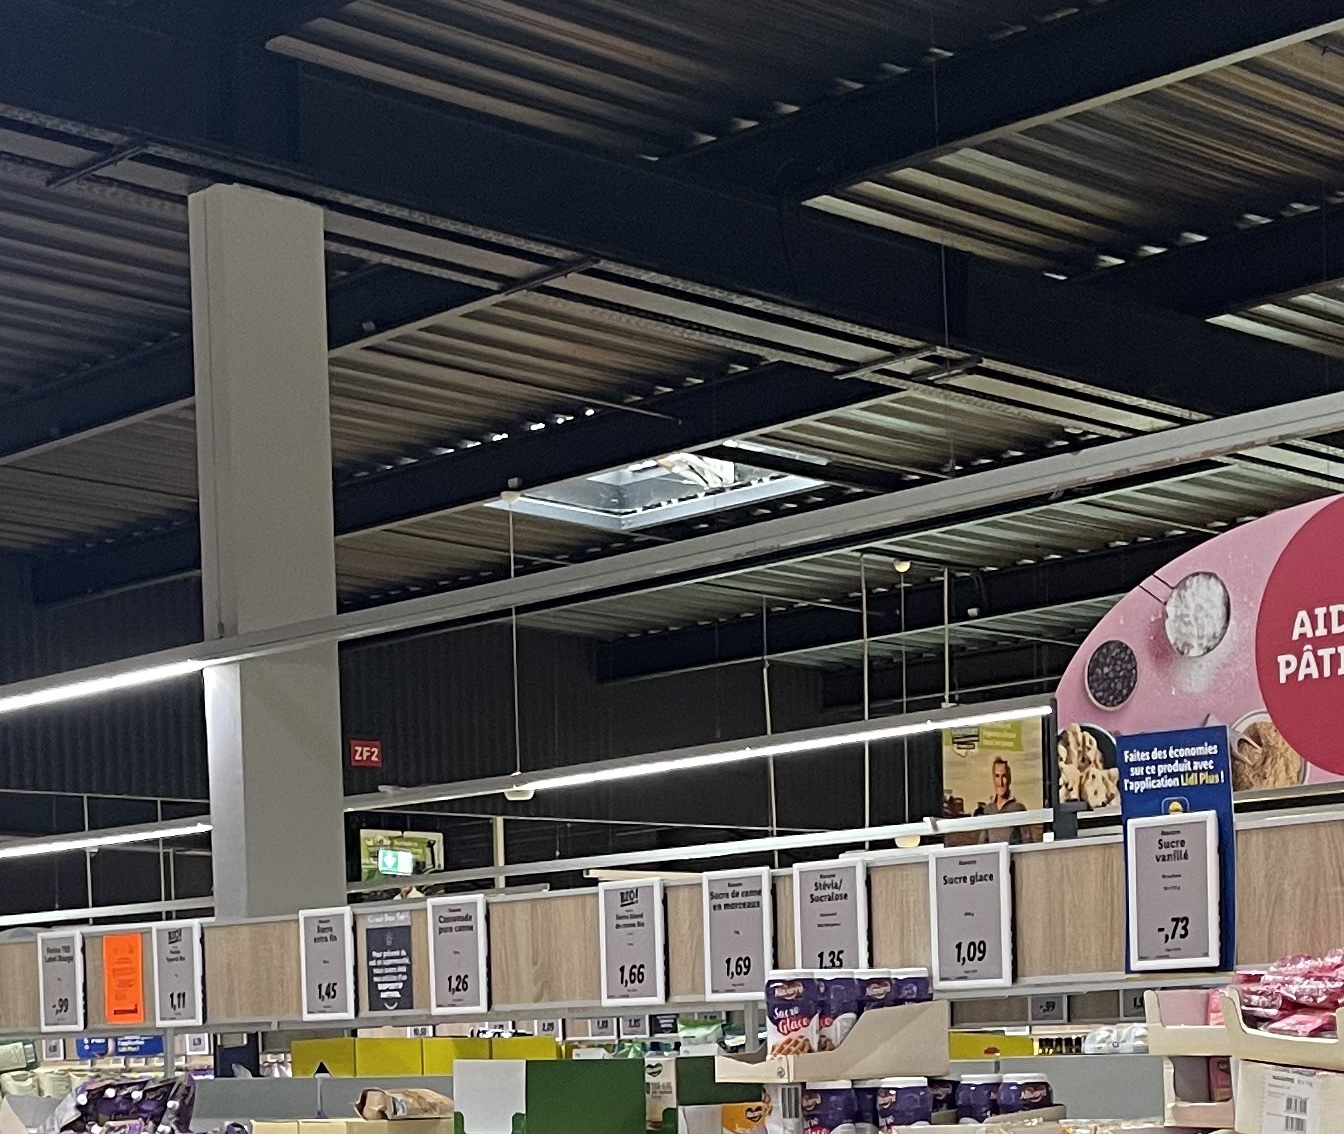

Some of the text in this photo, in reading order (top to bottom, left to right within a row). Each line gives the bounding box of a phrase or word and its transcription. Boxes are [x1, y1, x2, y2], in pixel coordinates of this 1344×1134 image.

[353, 746, 380, 762] ZF2
[1123, 743, 1218, 763] Faites des économies
[1130, 759, 1214, 777] sur ce produit avec
[1124, 772, 1219, 793] l'application Lidl Plus
[1157, 837, 1186, 850] Sucre
[943, 872, 994, 886] Sucre glace
[1157, 916, 1190, 944] -,73
[955, 940, 987, 966] 1,09
[619, 964, 646, 988] 1,66
[725, 956, 752, 980] 1,69
[317, 982, 338, 1002] 1,45
[447, 974, 469, 995] 1,26
